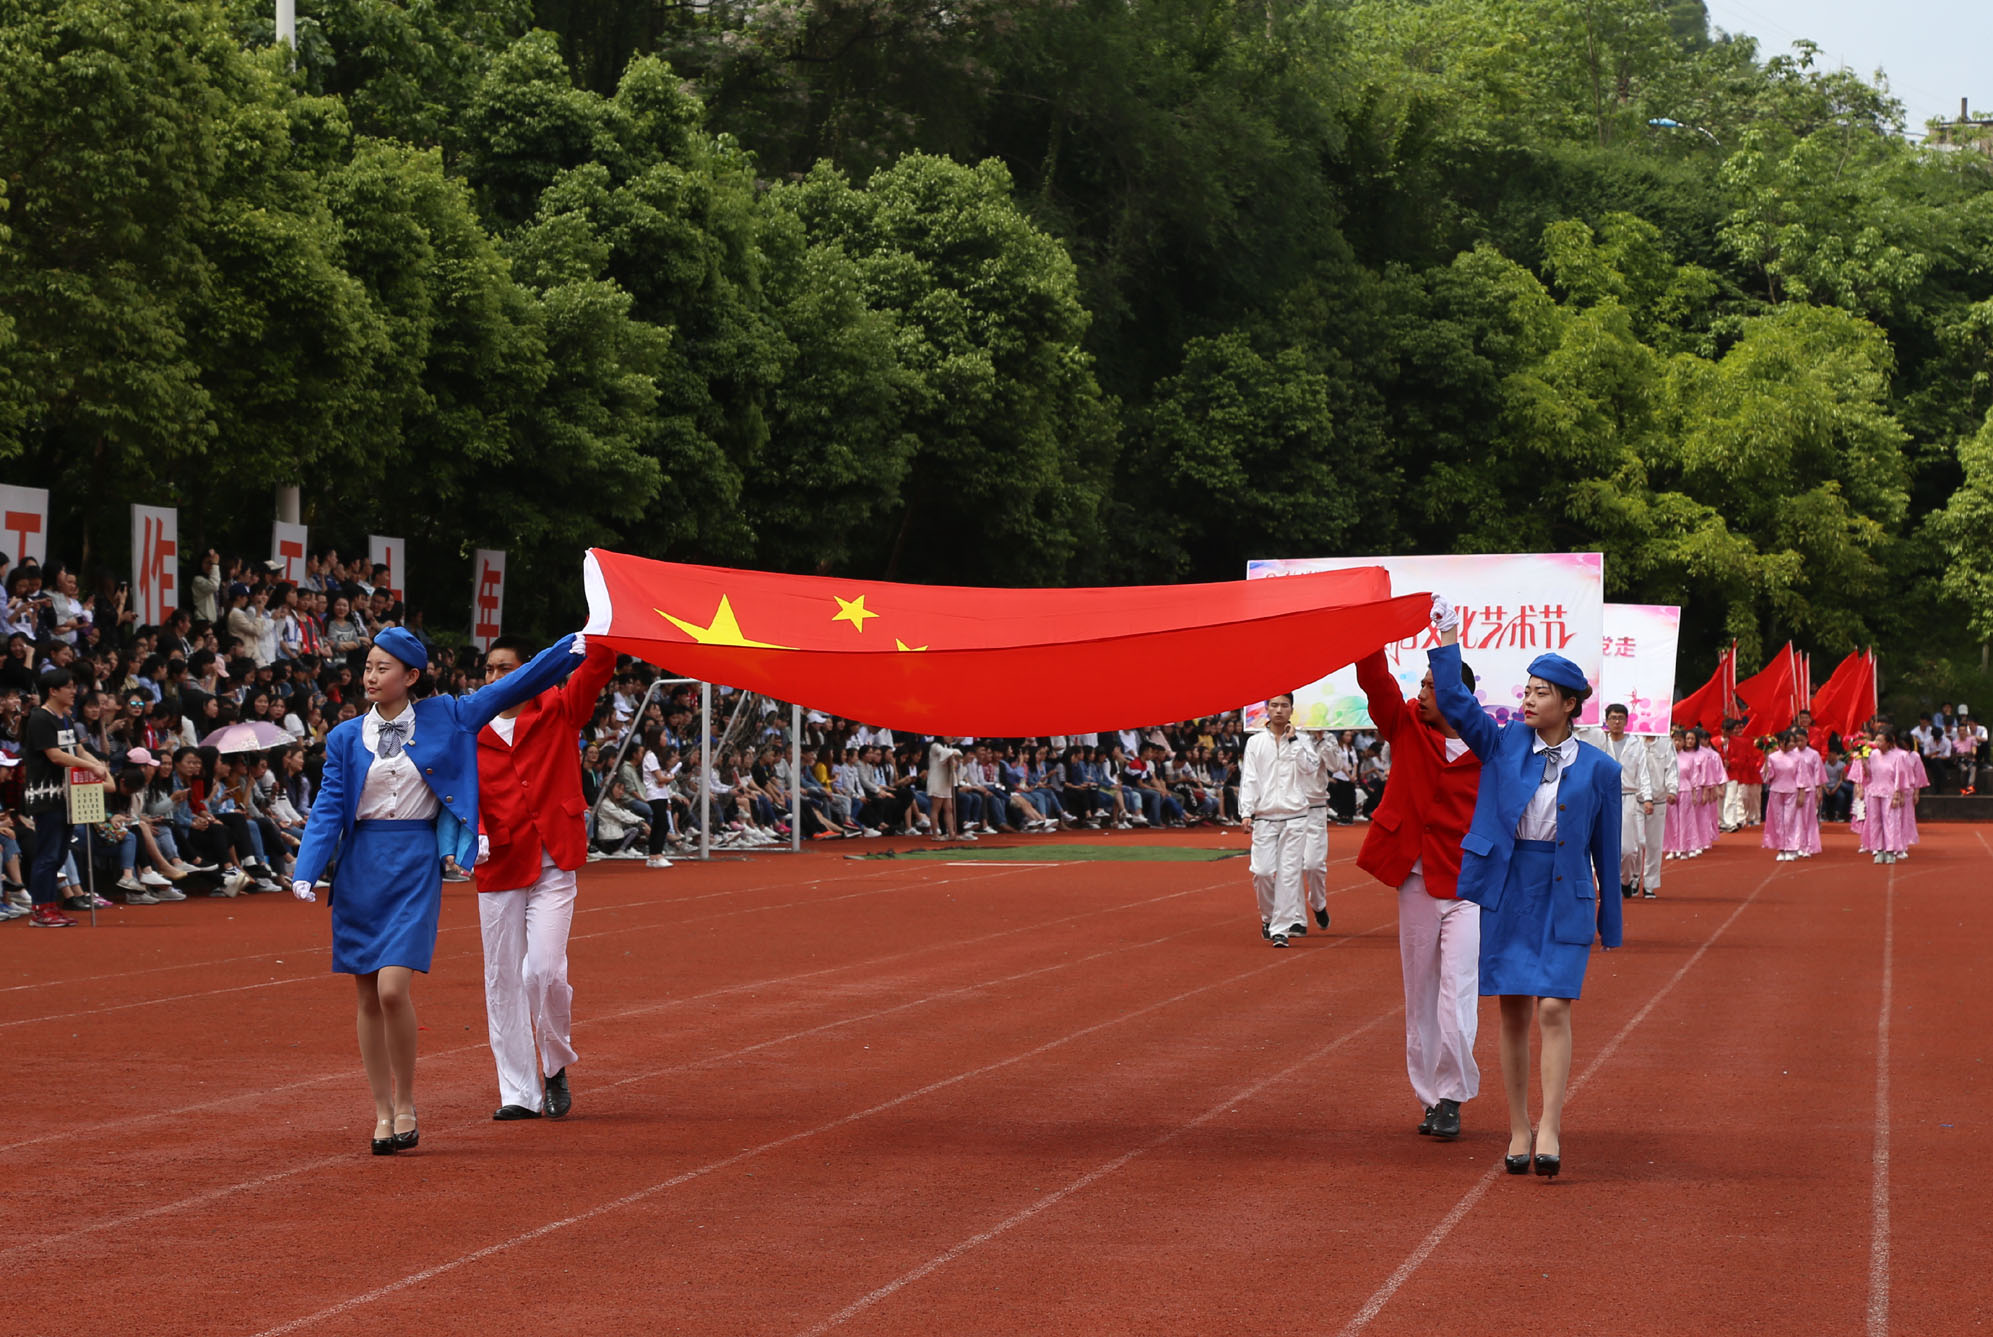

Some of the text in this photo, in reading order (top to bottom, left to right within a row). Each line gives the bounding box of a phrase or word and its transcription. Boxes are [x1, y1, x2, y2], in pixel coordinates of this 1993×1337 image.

[139, 516, 175, 626] 作
[477, 557, 502, 653] 年
[1384, 605, 1578, 667] 文化艺术节
